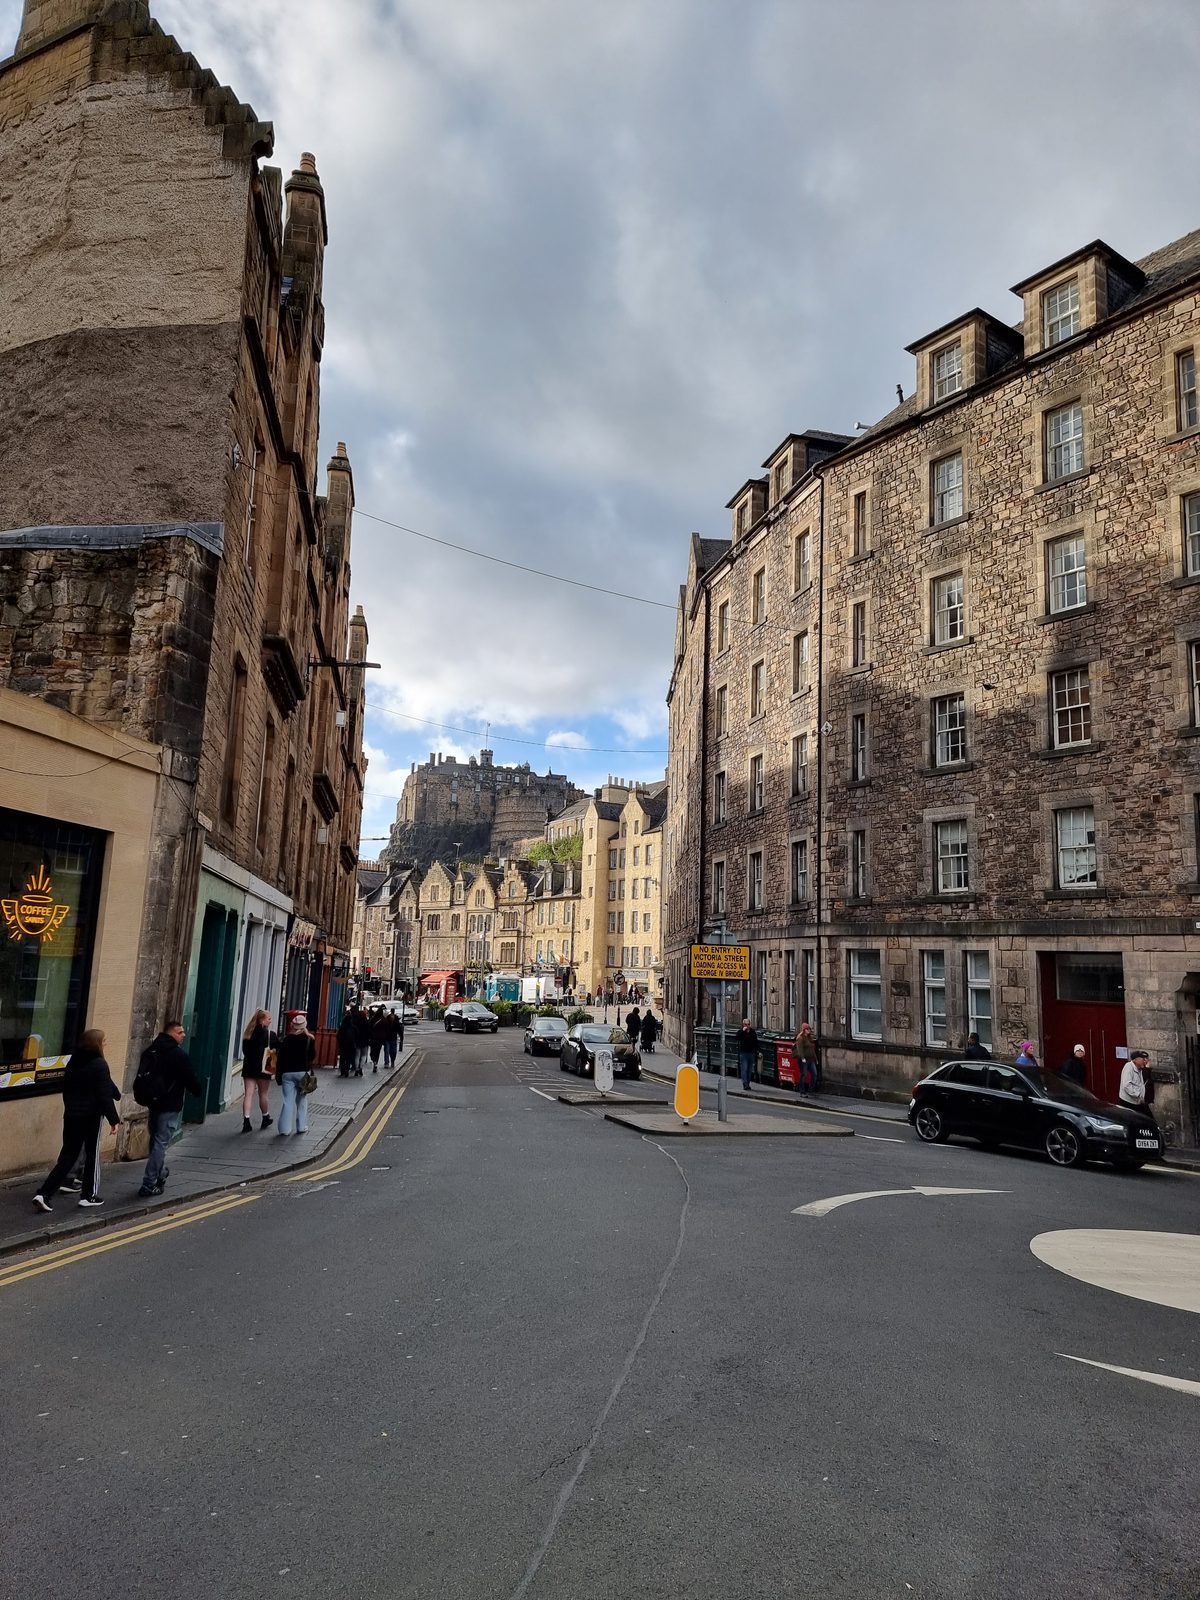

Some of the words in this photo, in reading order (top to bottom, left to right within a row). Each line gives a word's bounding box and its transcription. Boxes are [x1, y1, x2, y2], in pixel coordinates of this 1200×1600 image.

[20, 905, 52, 916] COFFEE
[717, 962, 737, 970] ACCESS
[697, 969, 717, 977] GEORGE
[725, 970, 744, 978] BRIDGE
